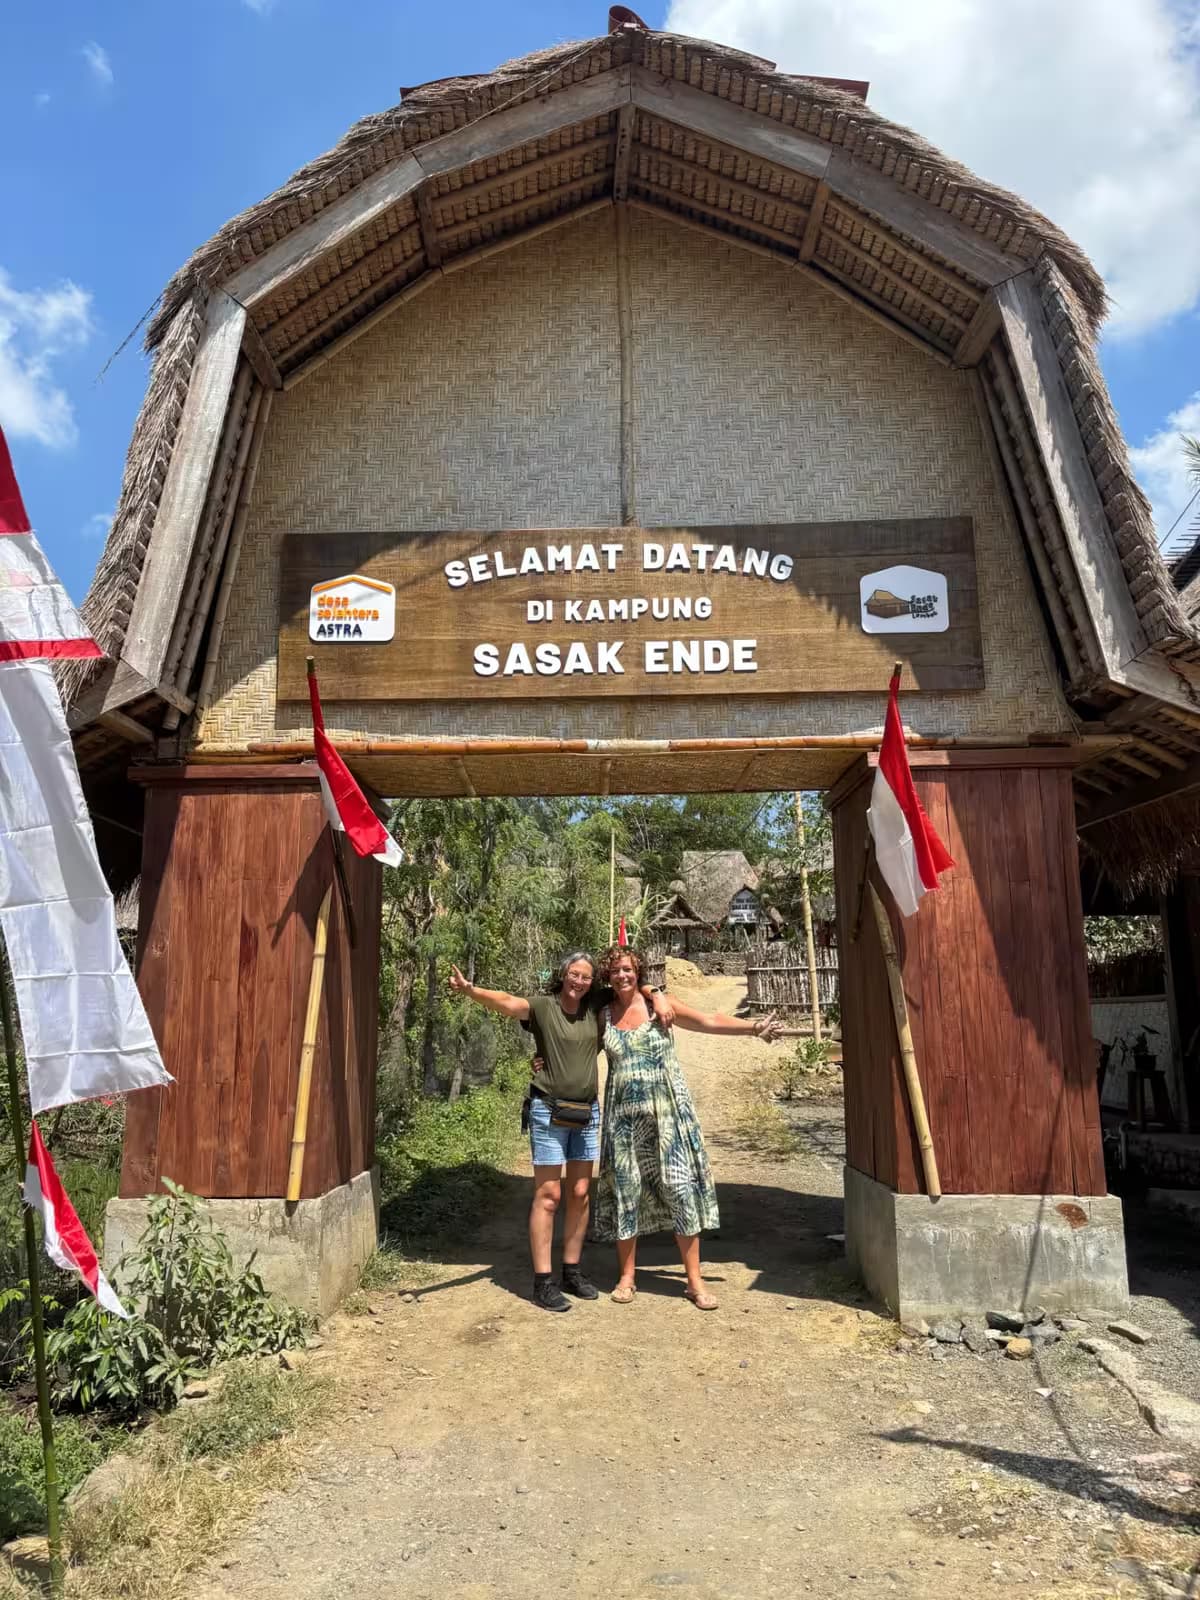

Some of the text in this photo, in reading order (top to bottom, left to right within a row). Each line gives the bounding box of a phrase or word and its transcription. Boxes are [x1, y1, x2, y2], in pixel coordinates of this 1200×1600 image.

[444, 543, 795, 587] SELAMAT DATANG
[527, 597, 713, 621] DI KAMPUNG
[316, 623, 362, 638] ASTRA
[473, 639, 758, 677] SASAK ENDE
